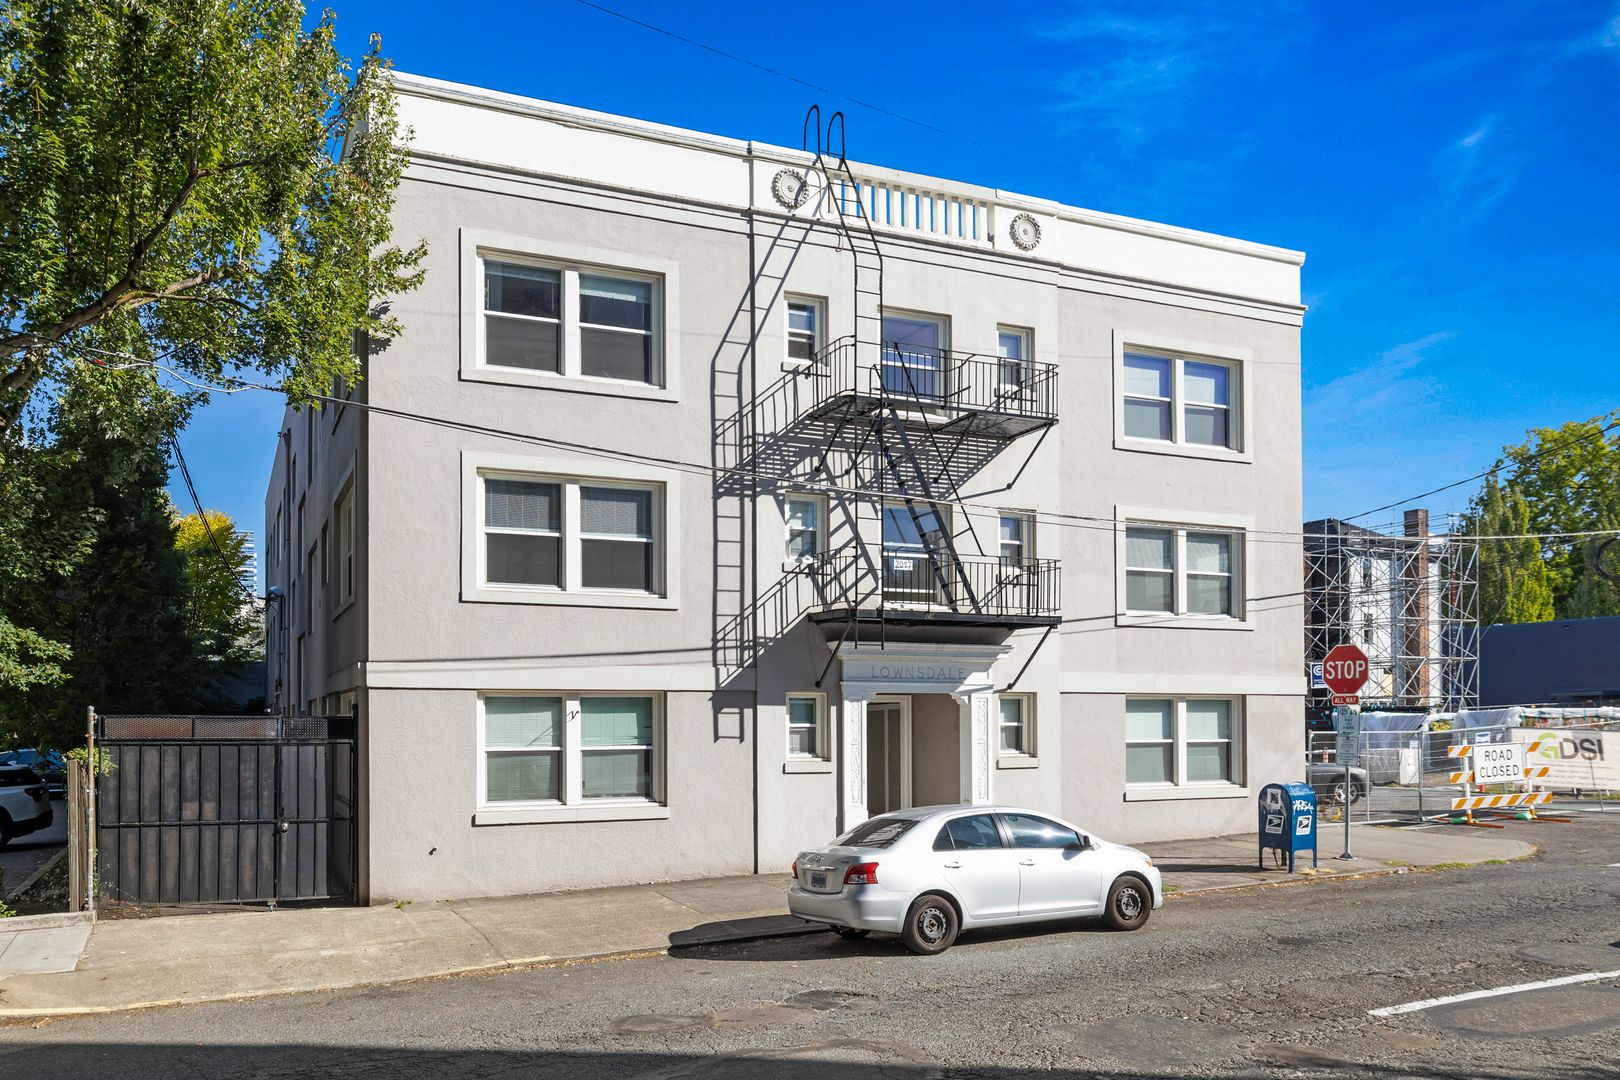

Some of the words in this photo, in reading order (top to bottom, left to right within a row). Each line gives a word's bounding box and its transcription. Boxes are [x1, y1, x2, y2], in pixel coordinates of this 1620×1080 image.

[871, 666, 967, 680] LOWNSDALE
[1325, 660, 1366, 680] STOP
[1334, 696, 1345, 704] ALL
[1346, 696, 1357, 704] WAY
[1484, 749, 1513, 762] ROAD
[1480, 764, 1520, 778] CLOSED
